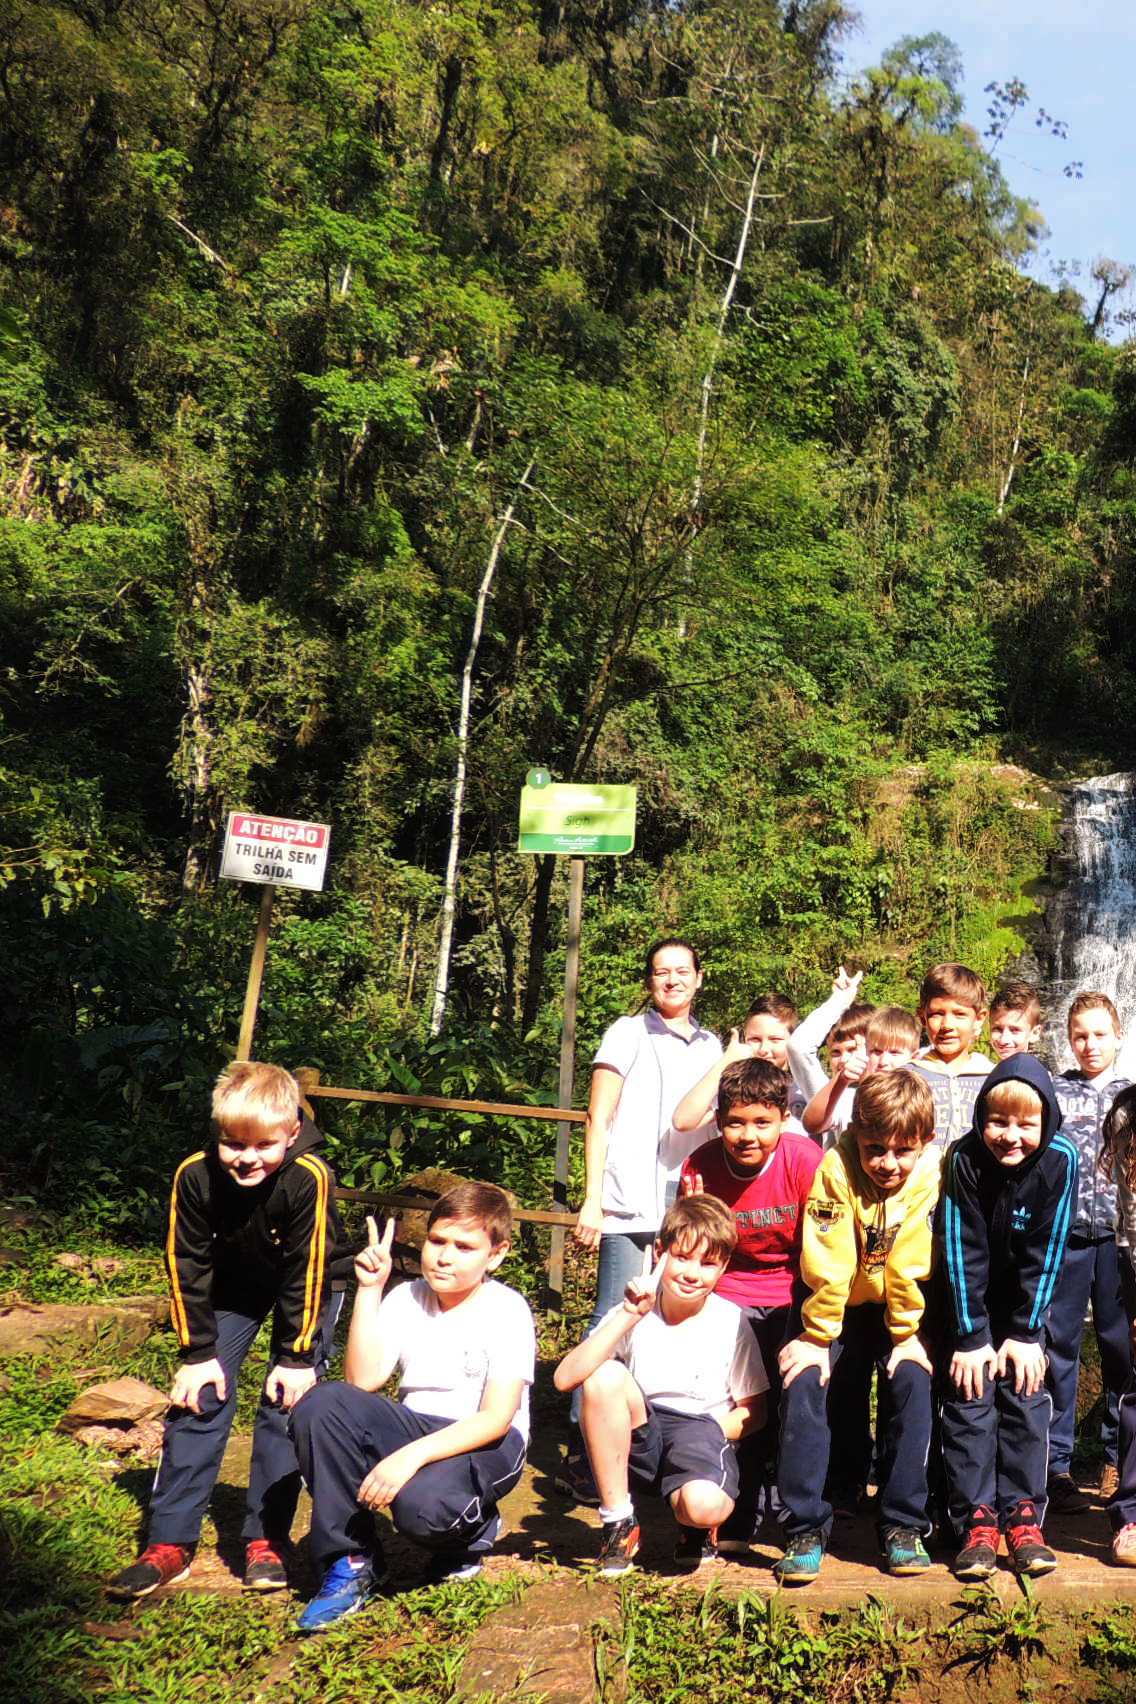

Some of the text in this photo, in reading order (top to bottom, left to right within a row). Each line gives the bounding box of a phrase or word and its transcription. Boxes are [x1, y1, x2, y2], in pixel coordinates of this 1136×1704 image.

[535, 773, 543, 785] 1
[239, 820, 319, 844] ATENÇÃO
[236, 843, 318, 865] TRILHA SEM
[253, 862, 294, 879] SAÍDA
